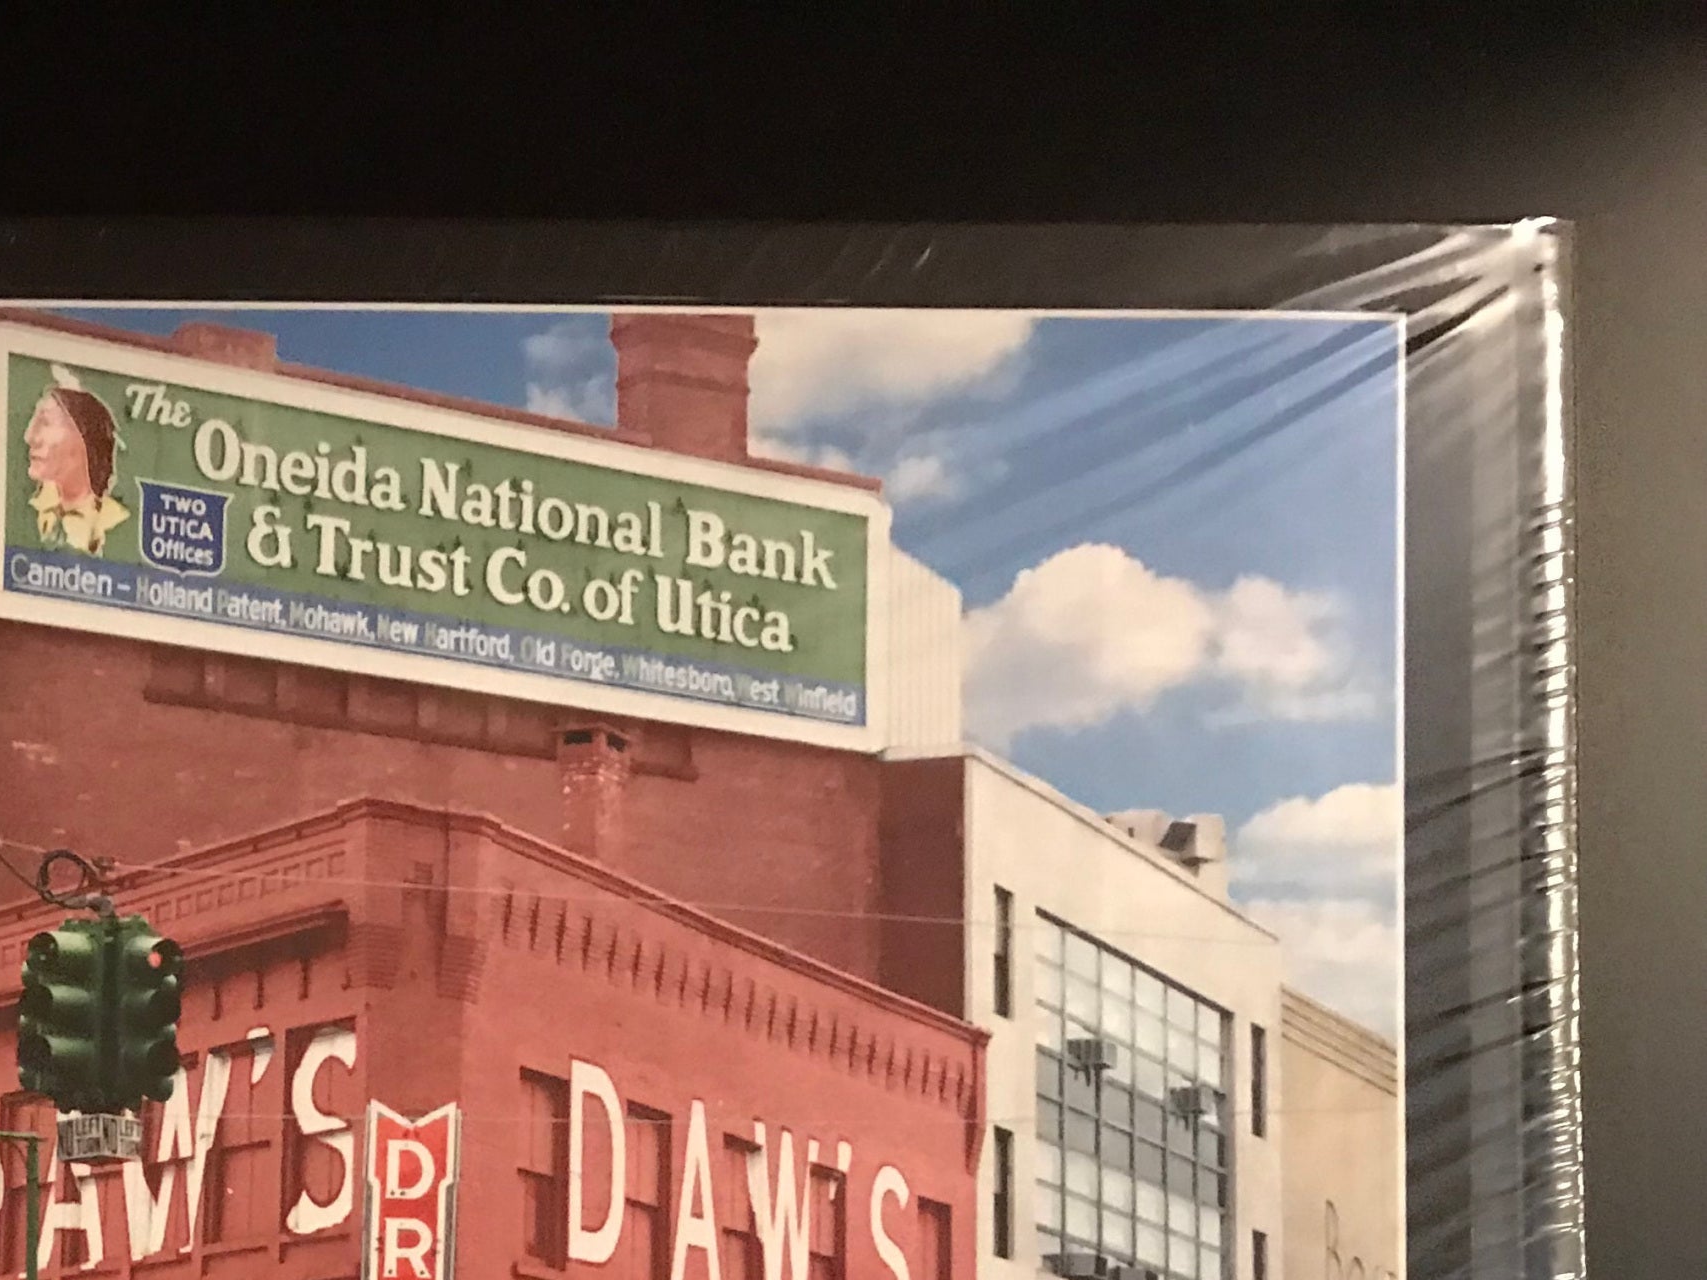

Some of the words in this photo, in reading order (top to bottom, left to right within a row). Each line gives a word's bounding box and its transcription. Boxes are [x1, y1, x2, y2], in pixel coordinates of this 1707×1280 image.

[125, 383, 191, 429] The
[160, 495, 207, 518] TWO
[193, 418, 405, 516] Oneida
[419, 459, 665, 559] National
[686, 509, 838, 590] Bank
[151, 513, 215, 544] UTICA
[150, 539, 216, 569] Offices
[246, 504, 293, 568] &
[308, 513, 473, 597] Trust
[485, 546, 571, 617] Co.
[584, 566, 645, 628] of
[654, 574, 795, 653] Utica
[10, 553, 112, 596] Camden
[136, 576, 213, 615] Holland
[217, 588, 287, 627] Patent,
[290, 600, 375, 639] Mohawk,
[378, 613, 418, 646] New
[521, 635, 555, 667] Old
